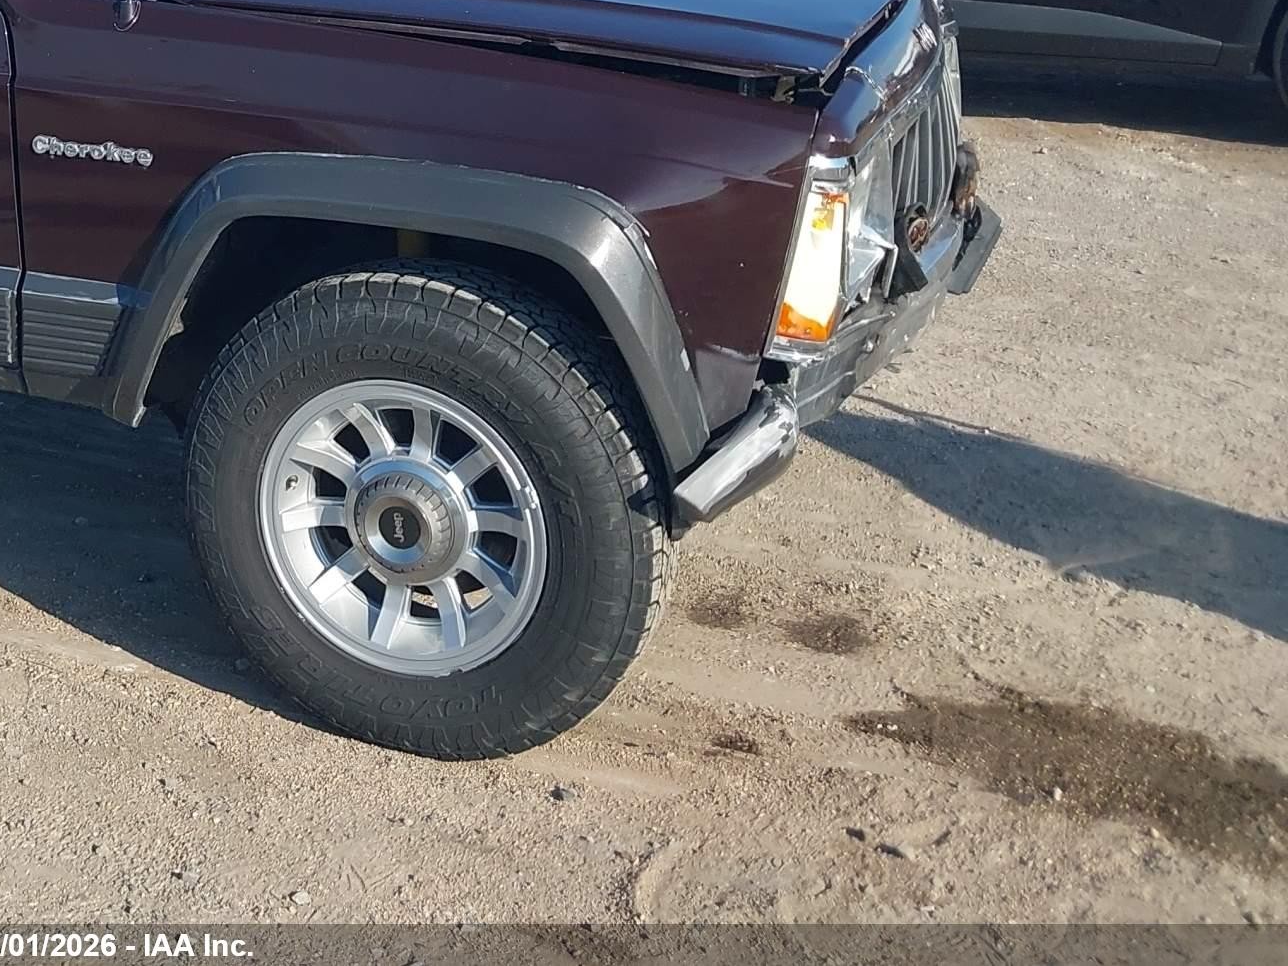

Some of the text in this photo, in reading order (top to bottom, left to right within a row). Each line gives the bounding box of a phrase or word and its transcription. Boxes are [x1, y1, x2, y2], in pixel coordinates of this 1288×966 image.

[32, 135, 154, 167] Cherokee
[243, 348, 329, 428] OPEN
[336, 342, 535, 427] COUNTRY
[393, 512, 405, 544] Jeep
[378, 684, 504, 721] TOYO
